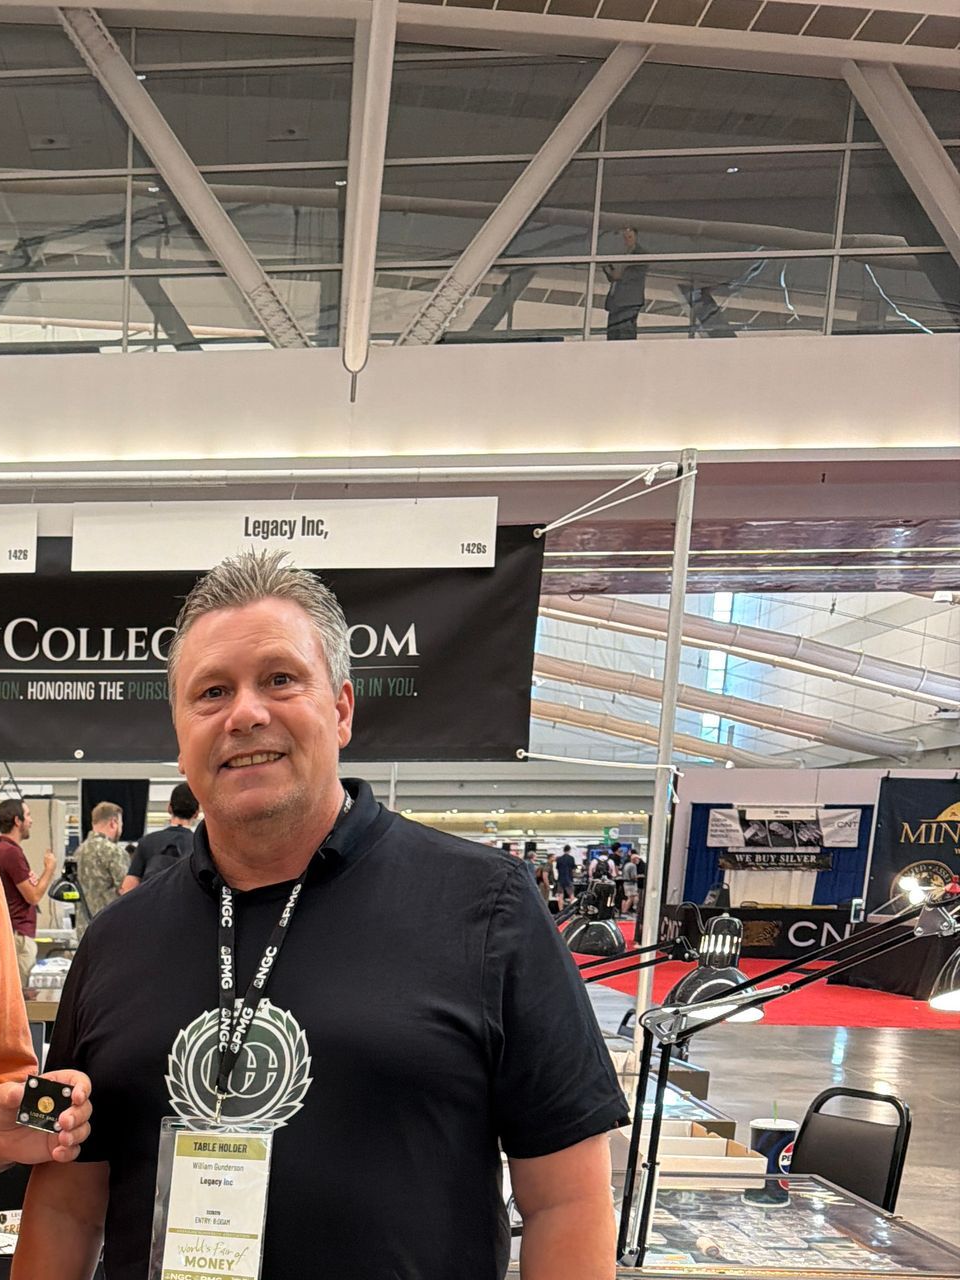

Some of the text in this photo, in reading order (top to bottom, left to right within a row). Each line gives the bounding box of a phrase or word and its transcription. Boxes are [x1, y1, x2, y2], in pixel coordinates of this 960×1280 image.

[244, 515, 329, 539] Legacy Inc,
[8, 550, 28, 560] 1426
[460, 542, 487, 554] 1426s
[28, 681, 95, 700] HONORING
[99, 682, 124, 700] THE
[128, 682, 169, 700] PURSU
[369, 678, 382, 697] IN
[387, 677, 419, 697] YOU.
[735, 854, 817, 863] WE BUY SILVER
[221, 894, 233, 928] NGC
[282, 883, 302, 919] PMG
[788, 920, 852, 947] CN
[220, 954, 233, 990] PMG
[257, 946, 278, 980] NGC
[233, 1007, 254, 1045] PMG
[193, 1142, 248, 1154] TABLE HOLDER
[200, 1177, 222, 1187] Legacy
[184, 1255, 235, 1271] MONEY
